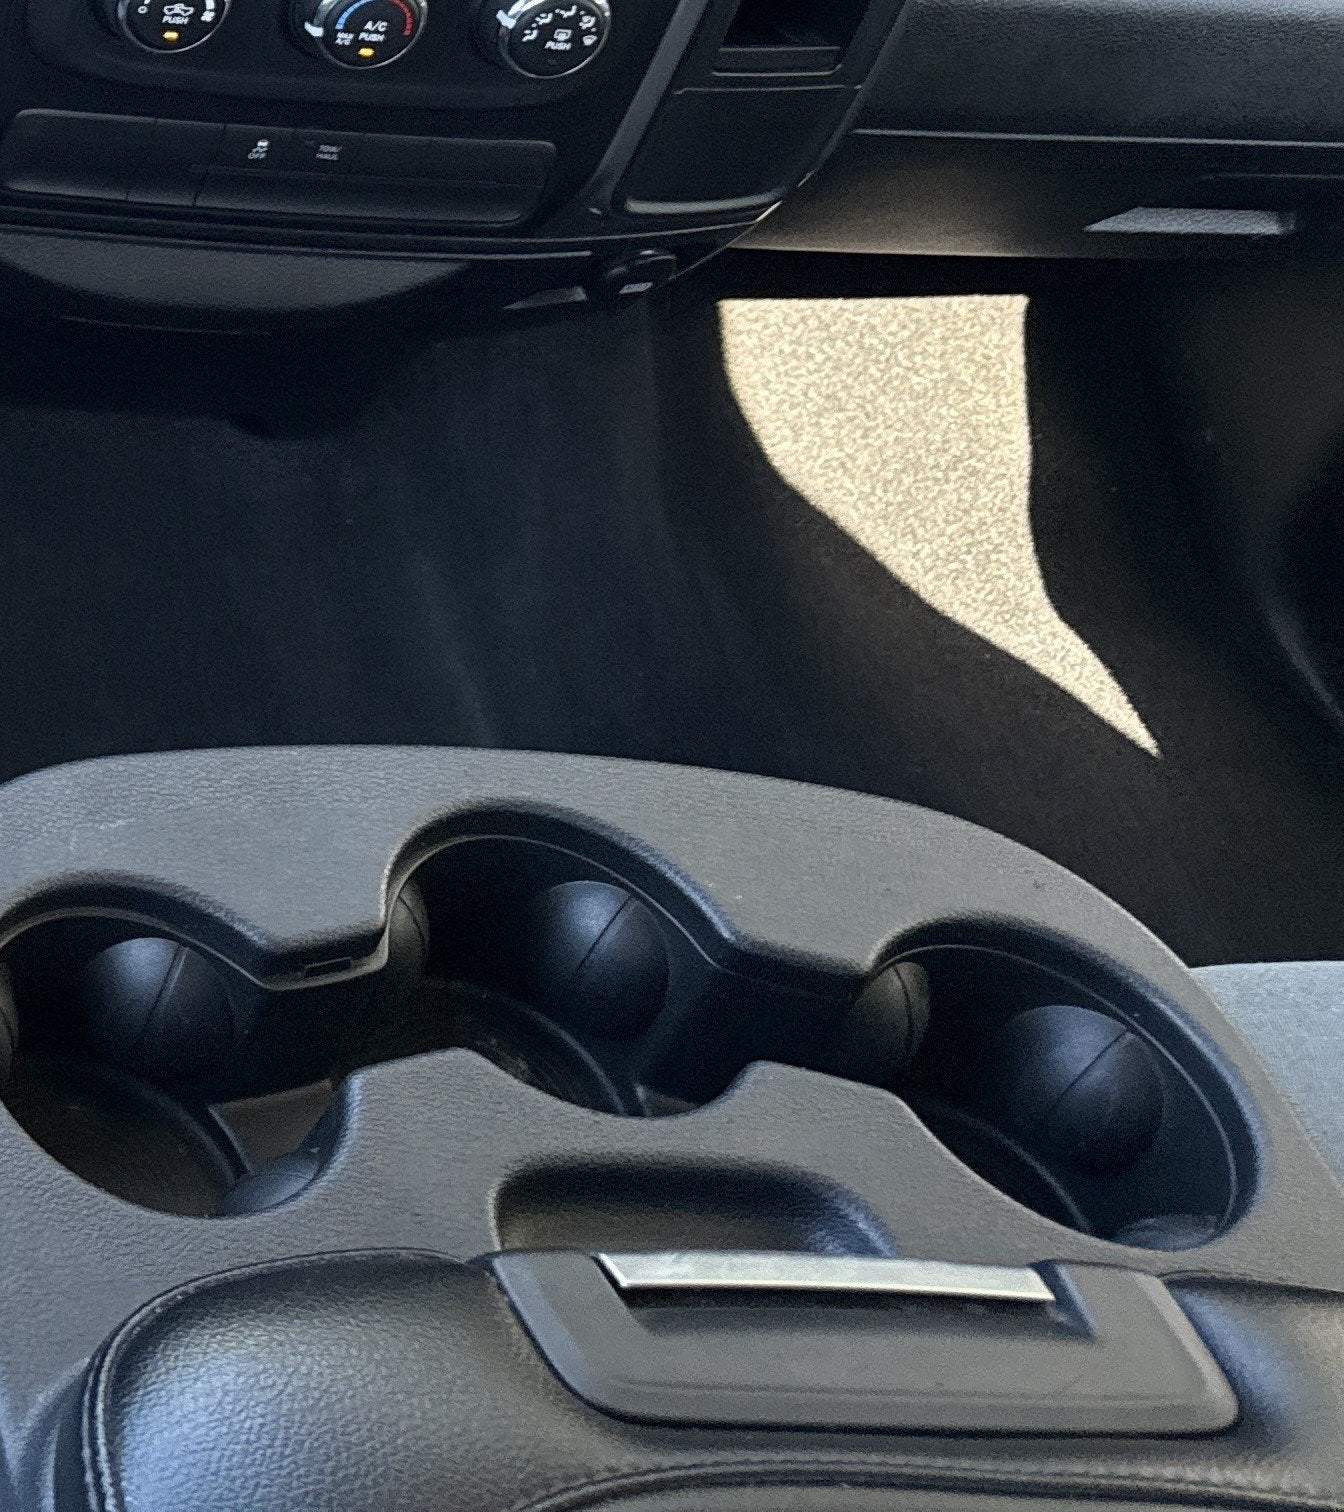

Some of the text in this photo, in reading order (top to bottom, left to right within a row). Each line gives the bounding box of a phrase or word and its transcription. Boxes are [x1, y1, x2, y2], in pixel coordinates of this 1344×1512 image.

[161, 15, 189, 25] PUSH
[363, 20, 388, 32] A/C
[358, 31, 386, 42] PUSH
